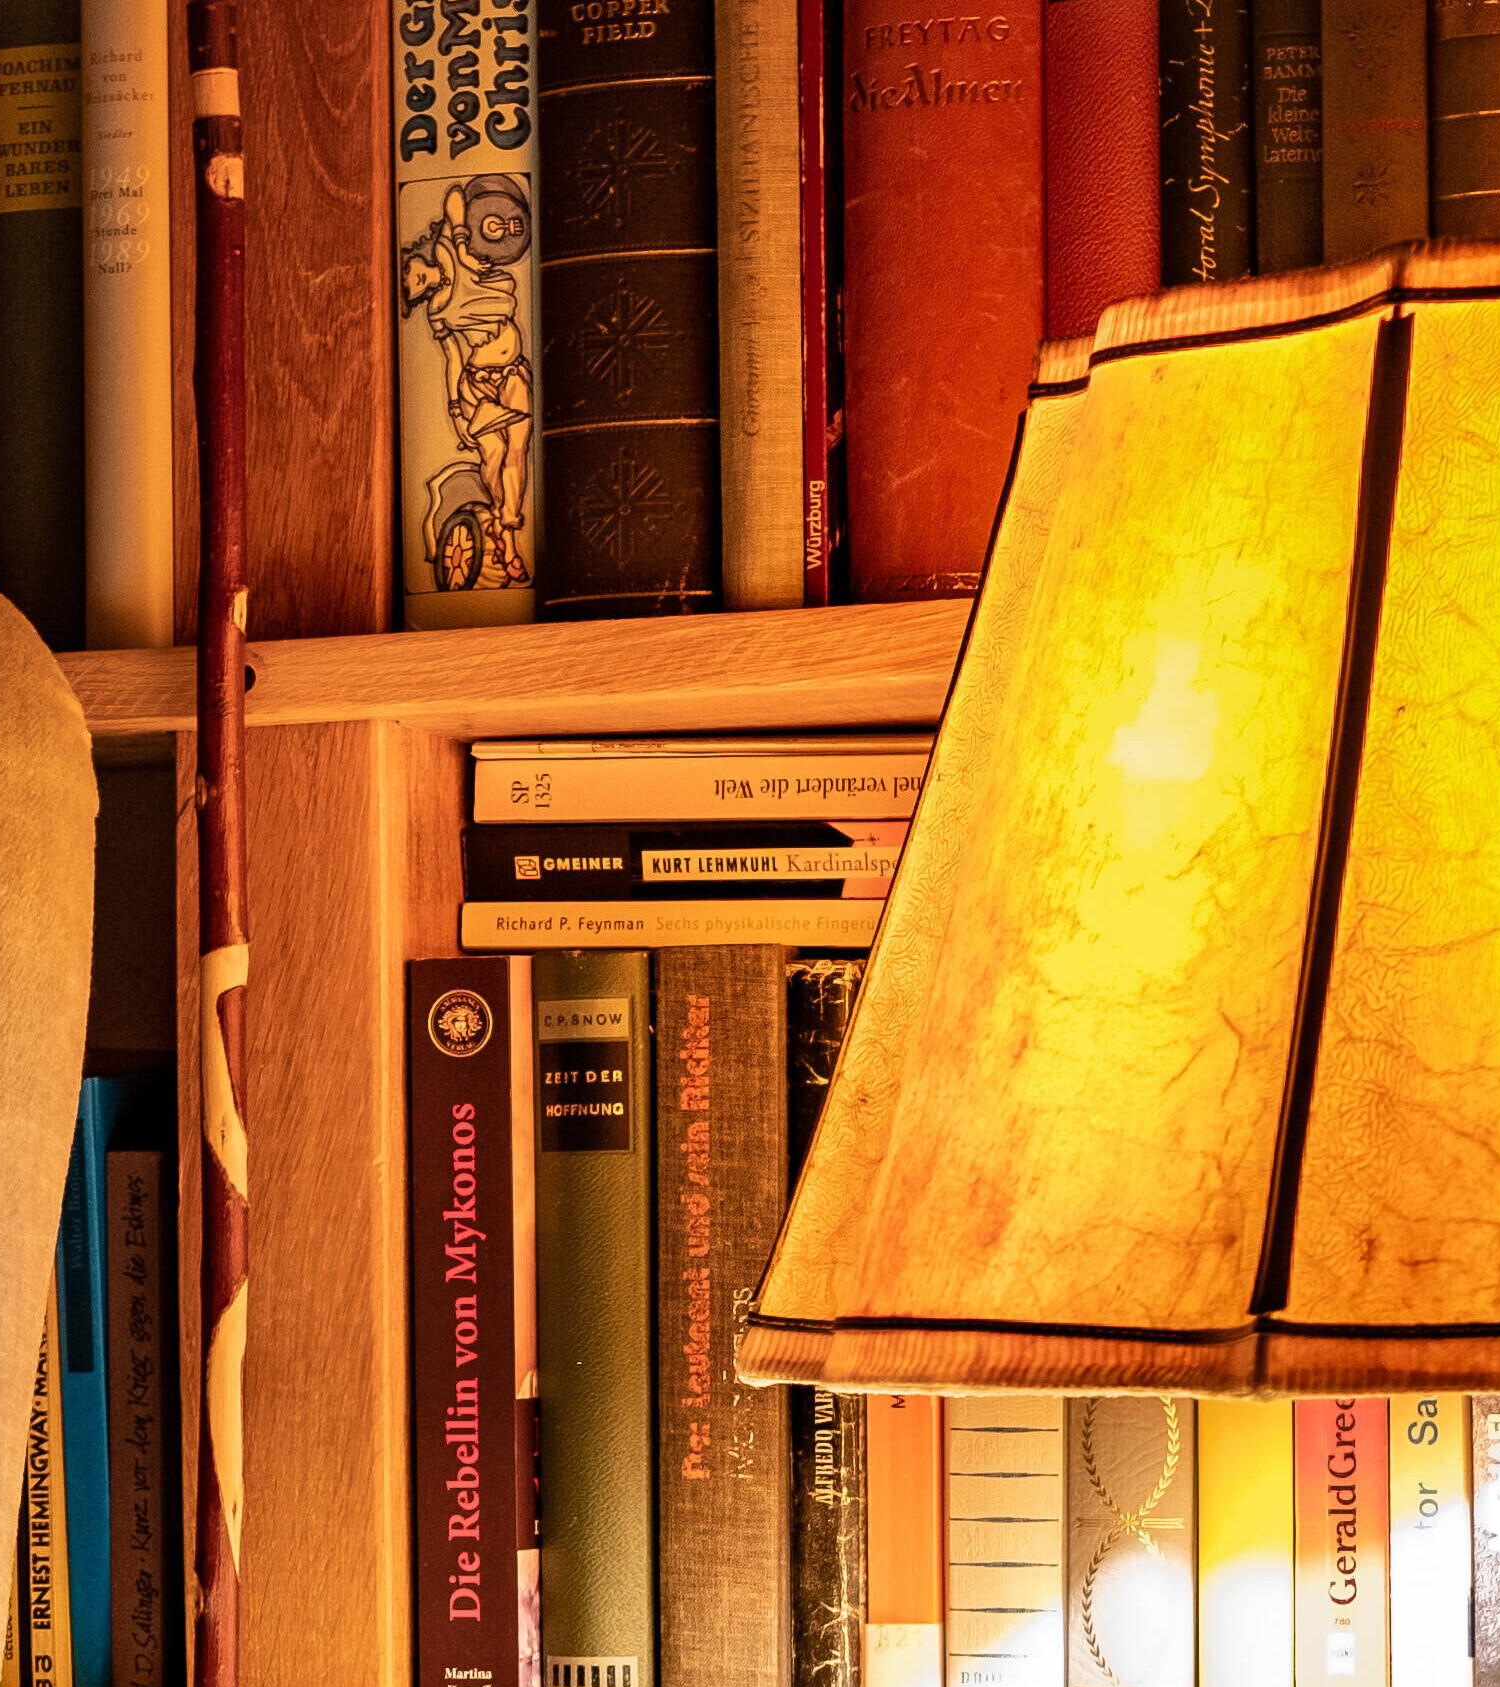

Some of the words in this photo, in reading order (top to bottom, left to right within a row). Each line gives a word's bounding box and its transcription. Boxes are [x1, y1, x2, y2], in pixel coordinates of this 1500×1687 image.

[581, 20, 657, 46] FIELD
[863, 19, 1013, 54] FREYTAG
[399, 50, 438, 163] Der
[446, 51, 481, 161] von
[17, 119, 52, 136] EIN
[4, 158, 70, 175] BARES
[4, 178, 71, 198] LEBEN
[805, 479, 825, 570] Würzburg
[510, 781, 530, 805] SP
[535, 772, 552, 809] 1325
[713, 778, 754, 799] Welt
[760, 778, 789, 799] die
[795, 776, 887, 800] verändert
[543, 856, 625, 871] GMEINER
[651, 856, 691, 875] KURT
[697, 855, 779, 874] LEHMKUHL
[496, 915, 553, 931] Richard
[560, 917, 571, 930] P.
[577, 916, 645, 934] Feynman
[544, 1070, 580, 1085] ZEIT
[585, 1069, 624, 1084] DER
[545, 1101, 625, 1117] HOFFNUNG
[442, 1102, 486, 1284] Mykonos
[451, 1293, 479, 1368] von
[445, 1376, 481, 1540] Rebellin
[812, 1429, 836, 1504] ALFREDO
[1329, 1482, 1359, 1606] Gerald
[31, 1553, 52, 1631] ERNEST
[447, 1551, 482, 1622] Die
[444, 1668, 492, 1679] Martina
